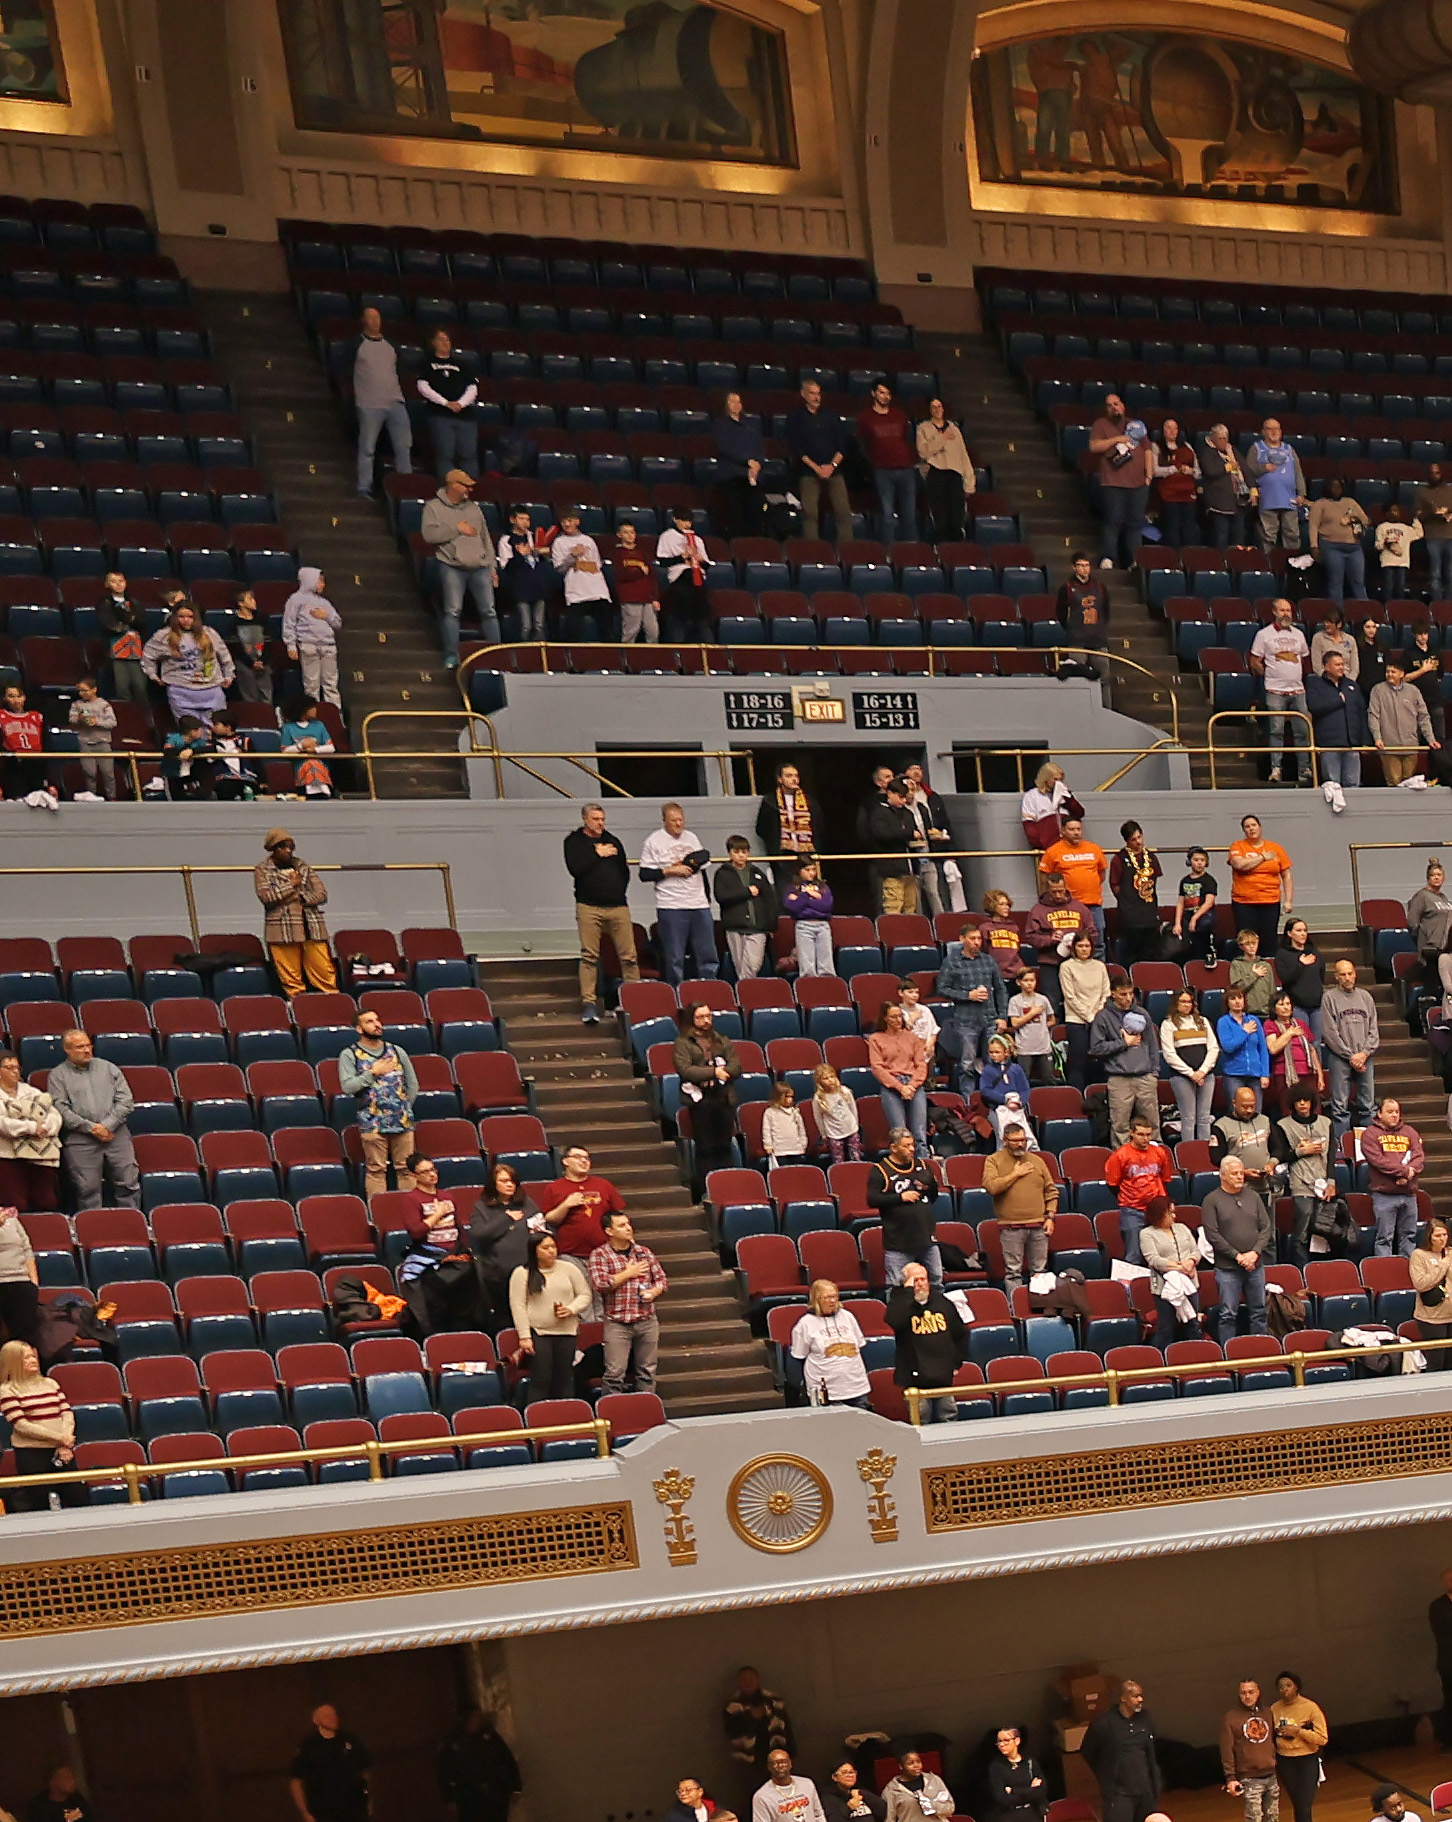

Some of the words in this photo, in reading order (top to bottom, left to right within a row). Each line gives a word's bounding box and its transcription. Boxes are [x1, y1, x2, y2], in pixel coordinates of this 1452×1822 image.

[742, 694, 784, 709] 18-16
[862, 694, 903, 709] 16-14
[809, 703, 837, 718] EXIT
[742, 714, 784, 727] 17-15
[865, 713, 904, 727] 15-13
[911, 1310, 947, 1334] CAVS
